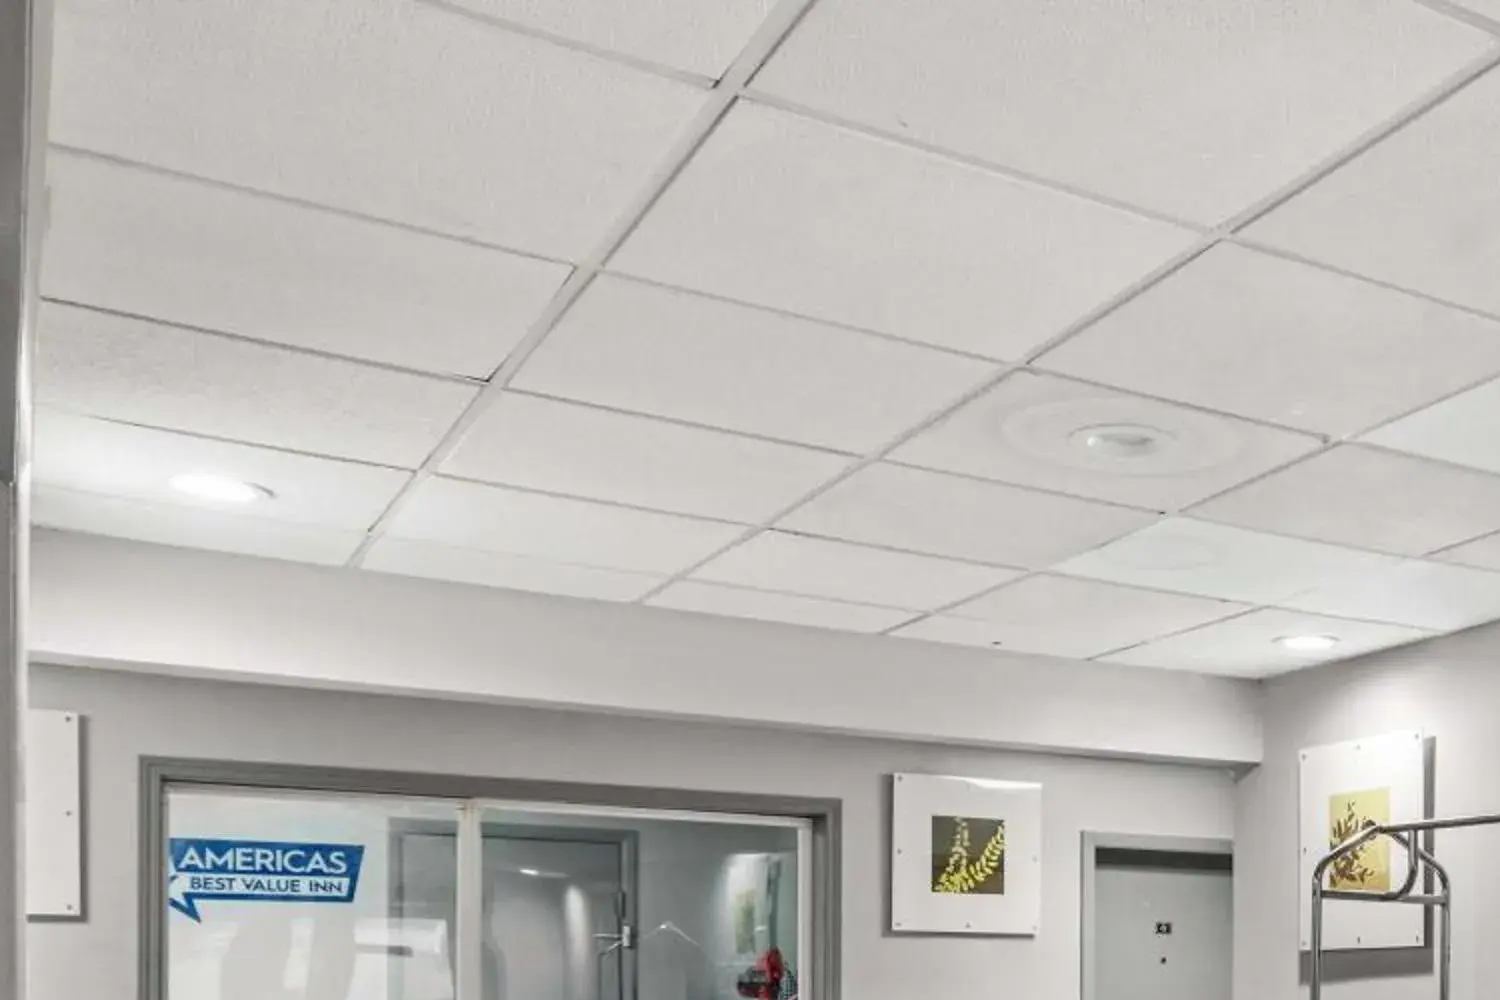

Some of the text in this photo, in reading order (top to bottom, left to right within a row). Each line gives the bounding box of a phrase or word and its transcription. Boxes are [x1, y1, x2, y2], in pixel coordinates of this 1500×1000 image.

[179, 847, 347, 874] AMERICAS
[190, 876, 343, 893] BEST VALUE INN
